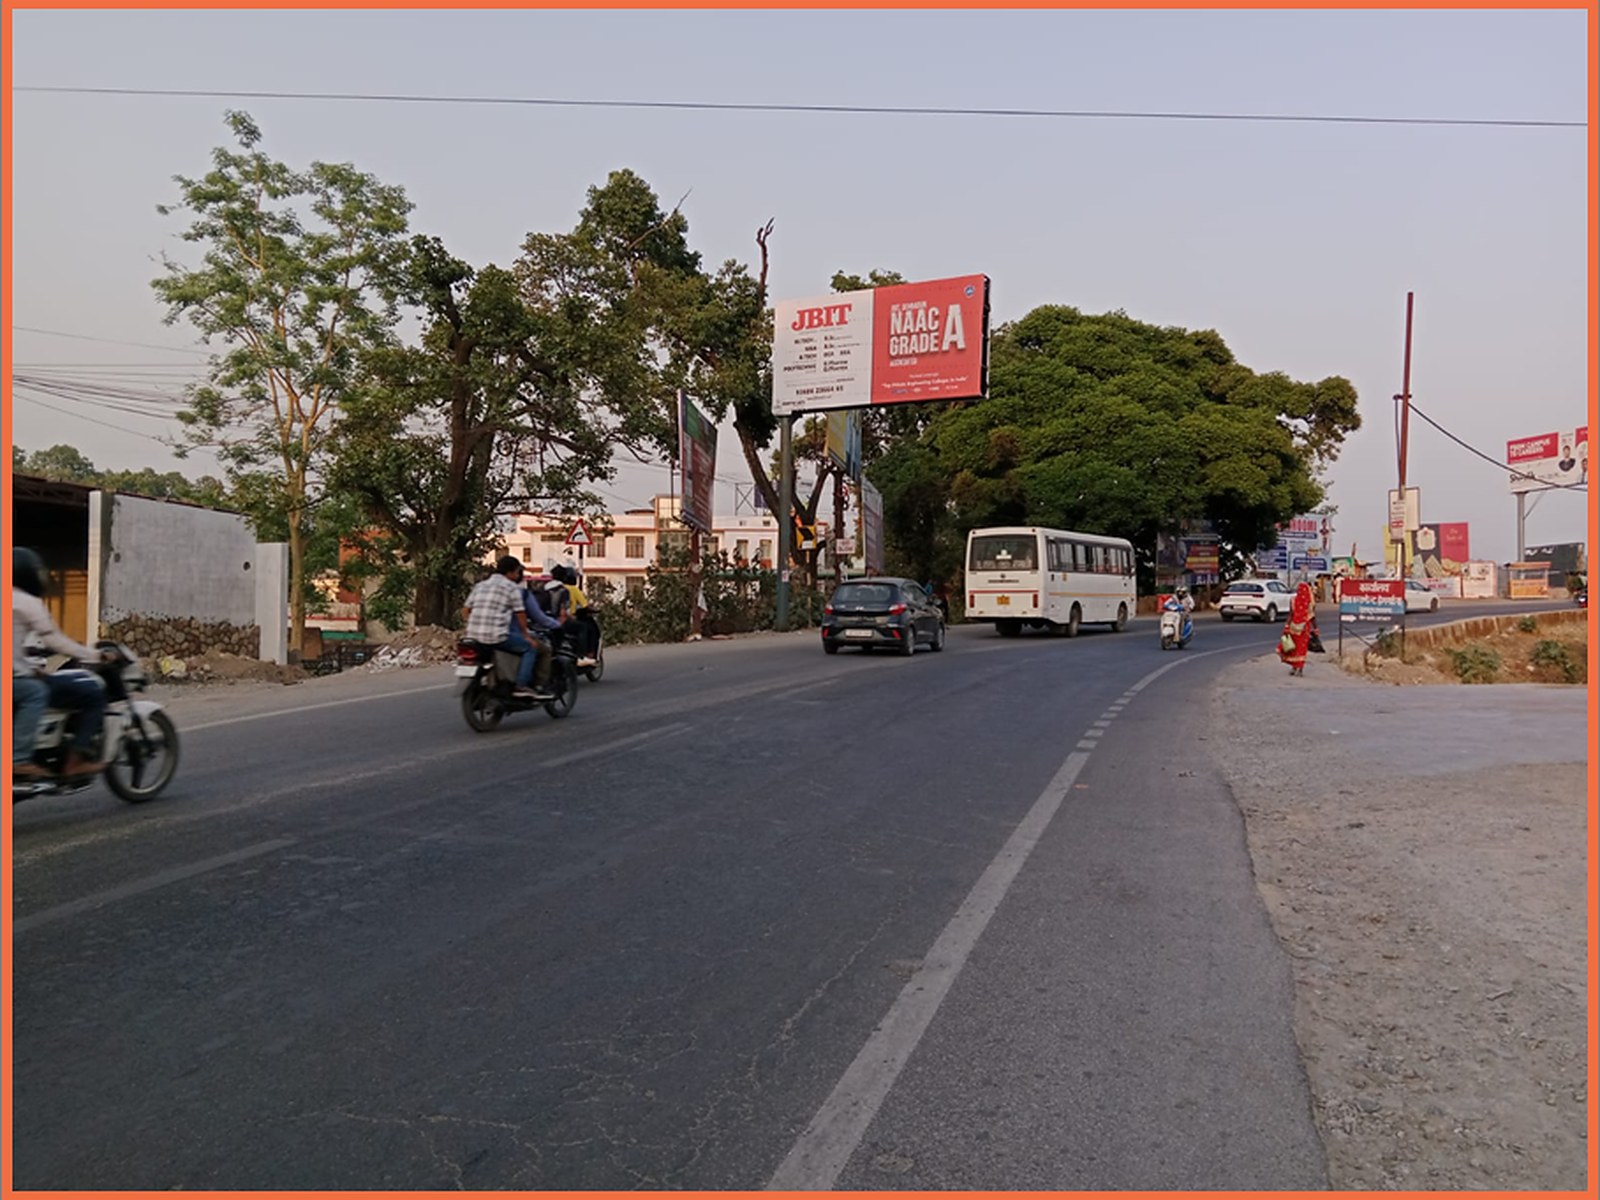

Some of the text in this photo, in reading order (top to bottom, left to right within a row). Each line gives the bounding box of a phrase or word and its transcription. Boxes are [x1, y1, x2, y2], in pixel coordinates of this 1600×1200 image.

[791, 303, 853, 331] JBIT
[890, 304, 966, 351] NAAC A
[889, 332, 940, 356] GRADE
